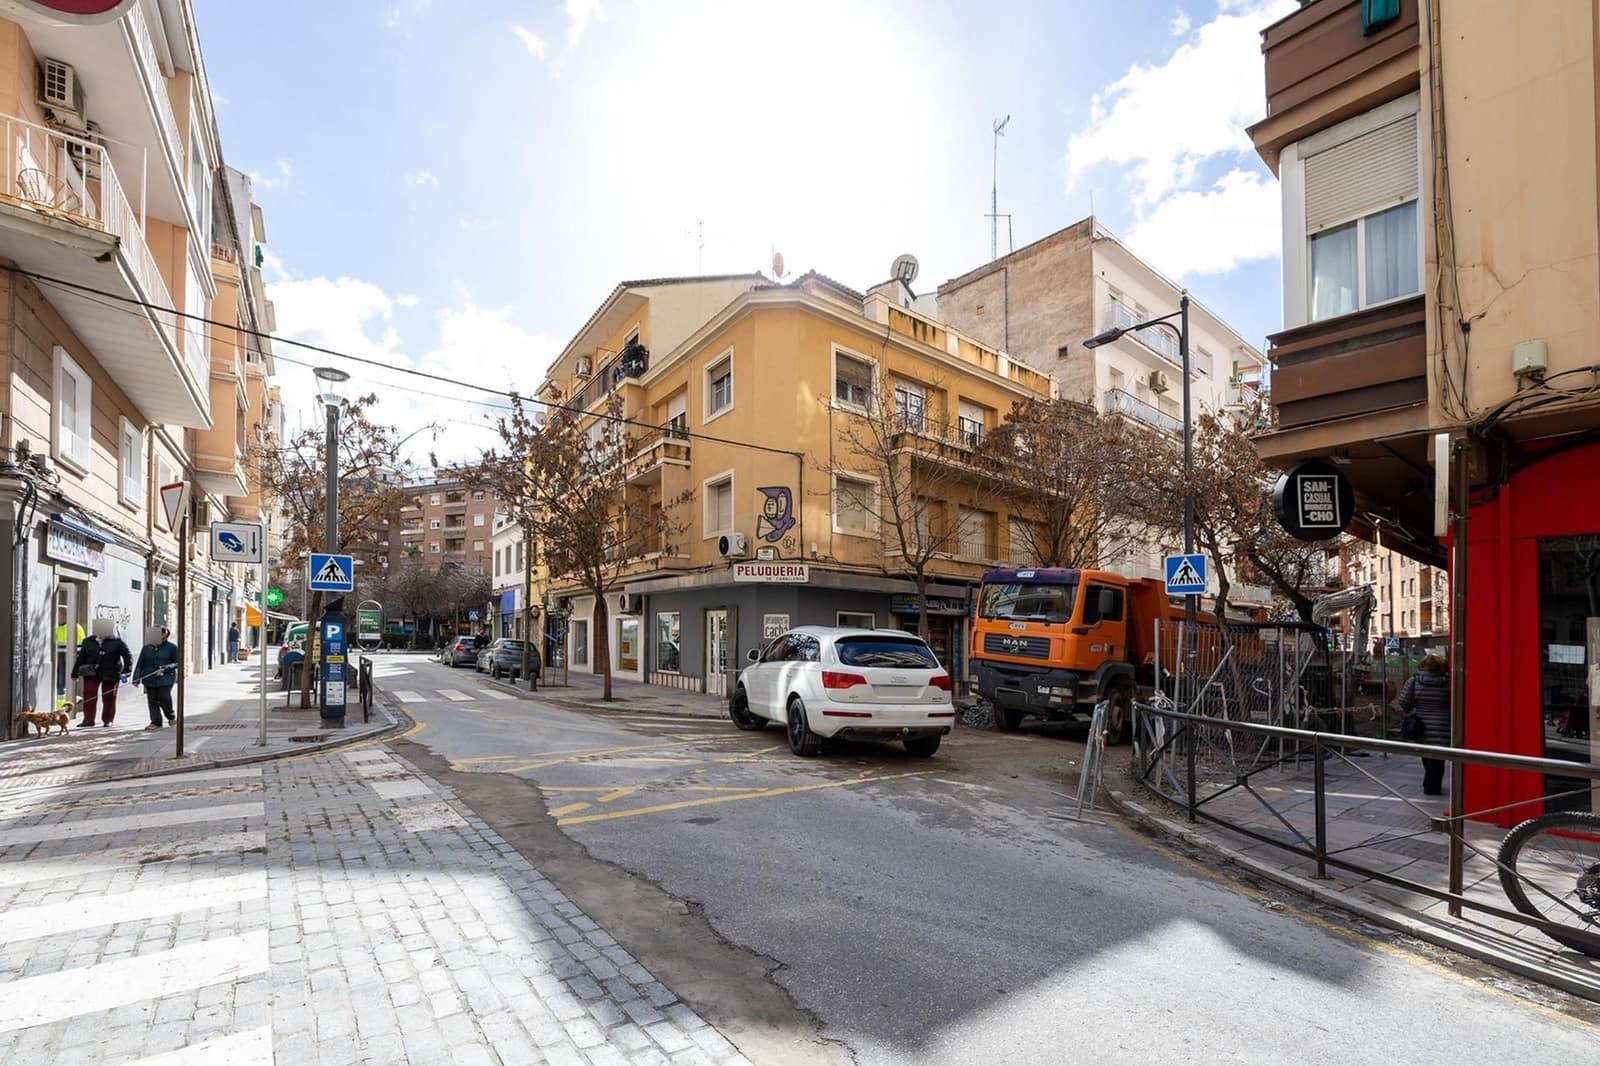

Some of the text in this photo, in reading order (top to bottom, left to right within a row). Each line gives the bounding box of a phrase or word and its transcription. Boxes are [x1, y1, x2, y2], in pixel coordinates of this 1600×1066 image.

[1303, 481, 1333, 492] SAN-
[1303, 492, 1333, 503] CASUAL
[1304, 511, 1334, 521] -CHO
[737, 566, 805, 577] PELUQUERIA
[327, 624, 341, 639] P
[1002, 638, 1028, 647] MAN
